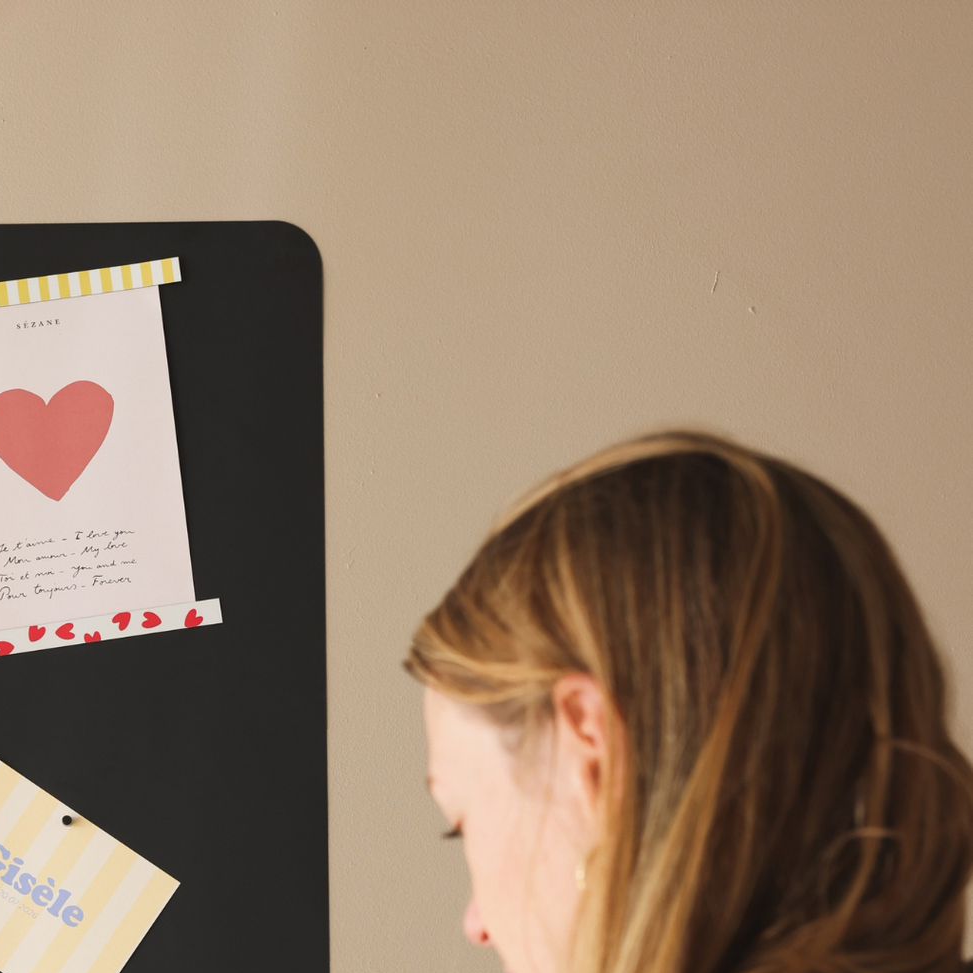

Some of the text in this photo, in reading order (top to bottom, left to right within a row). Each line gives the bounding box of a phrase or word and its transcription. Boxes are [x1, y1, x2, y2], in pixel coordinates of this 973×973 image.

[16, 319, 61, 330] SÉZANE
[74, 531, 84, 540] I
[86, 530, 109, 539] love
[3, 555, 31, 568] Mon
[36, 553, 67, 561] amour
[80, 546, 100, 558] My
[104, 541, 129, 551] love
[20, 571, 29, 580] et
[96, 560, 117, 569] and
[0, 586, 27, 601] Pour
[33, 583, 78, 599] toujours
[92, 575, 132, 587] Forever
